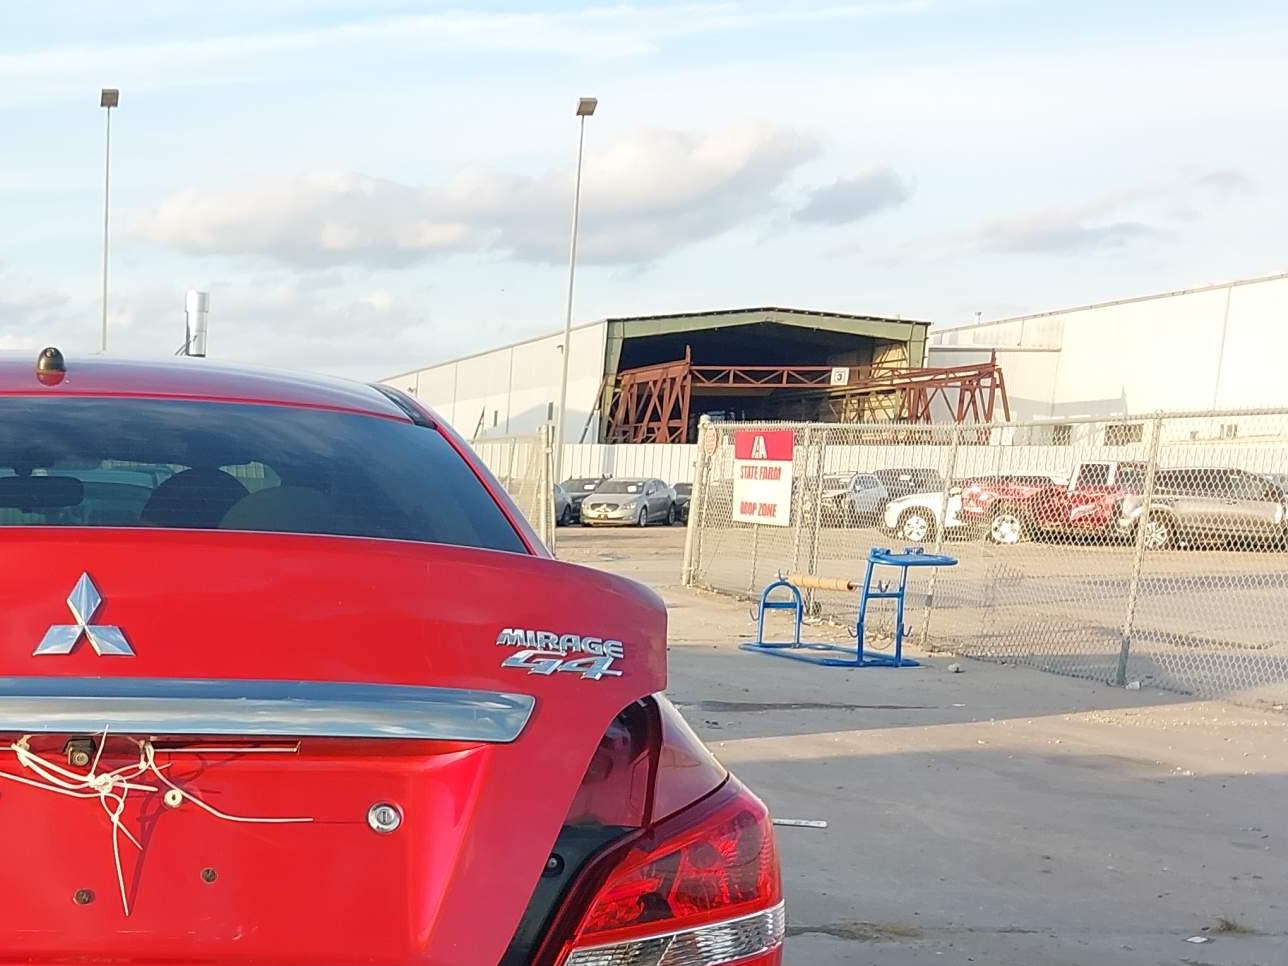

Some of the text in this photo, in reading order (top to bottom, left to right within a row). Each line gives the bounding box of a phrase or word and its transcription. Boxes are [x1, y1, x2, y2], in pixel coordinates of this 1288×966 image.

[740, 465, 782, 481] STATE FARM
[758, 502, 778, 518] ZONE
[496, 627, 624, 659] MIRAGE
[500, 648, 624, 681] G4
